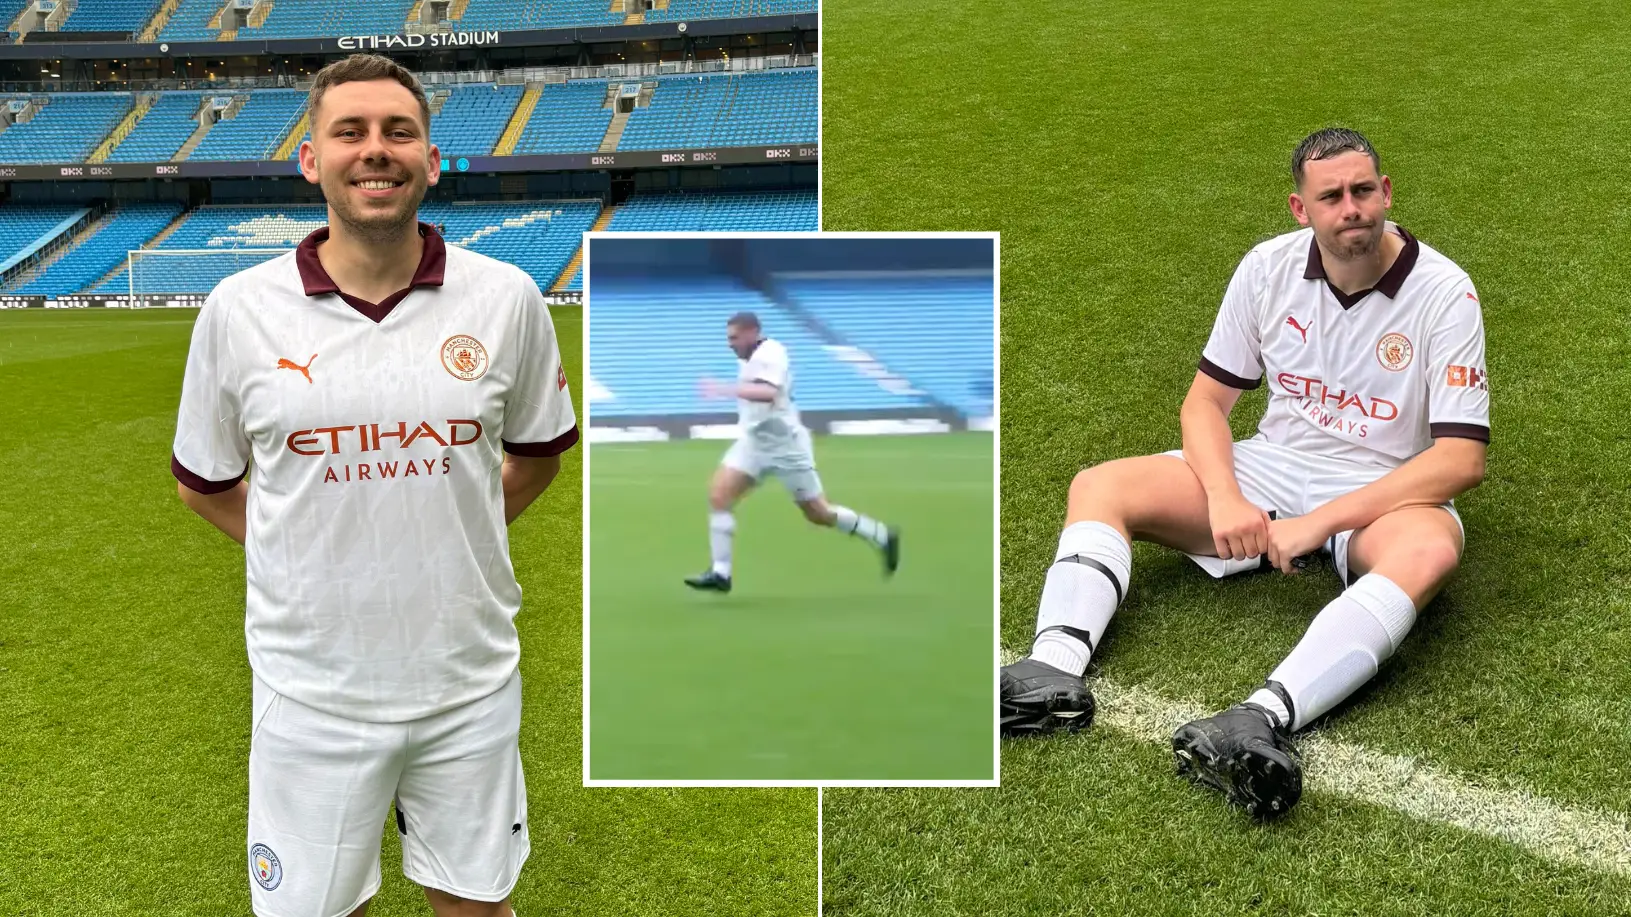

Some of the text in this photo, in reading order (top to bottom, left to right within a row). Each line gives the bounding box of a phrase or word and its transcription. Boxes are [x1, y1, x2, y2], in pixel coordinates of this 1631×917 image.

[338, 31, 499, 50] ETIHAD STADIUM
[661, 153, 685, 163] OKX
[693, 151, 717, 161] OKX
[766, 149, 791, 159] OKX
[591, 155, 615, 165] OKX
[60, 167, 83, 176] OKX
[90, 167, 113, 176] OKX
[156, 165, 179, 175] OKX
[446, 338, 483, 354] MANCHESTER
[1447, 364, 1487, 391] OK
[1277, 372, 1399, 421] ETIHAD
[286, 419, 483, 456] ETIHAD
[324, 456, 451, 484] AIRWAYS
